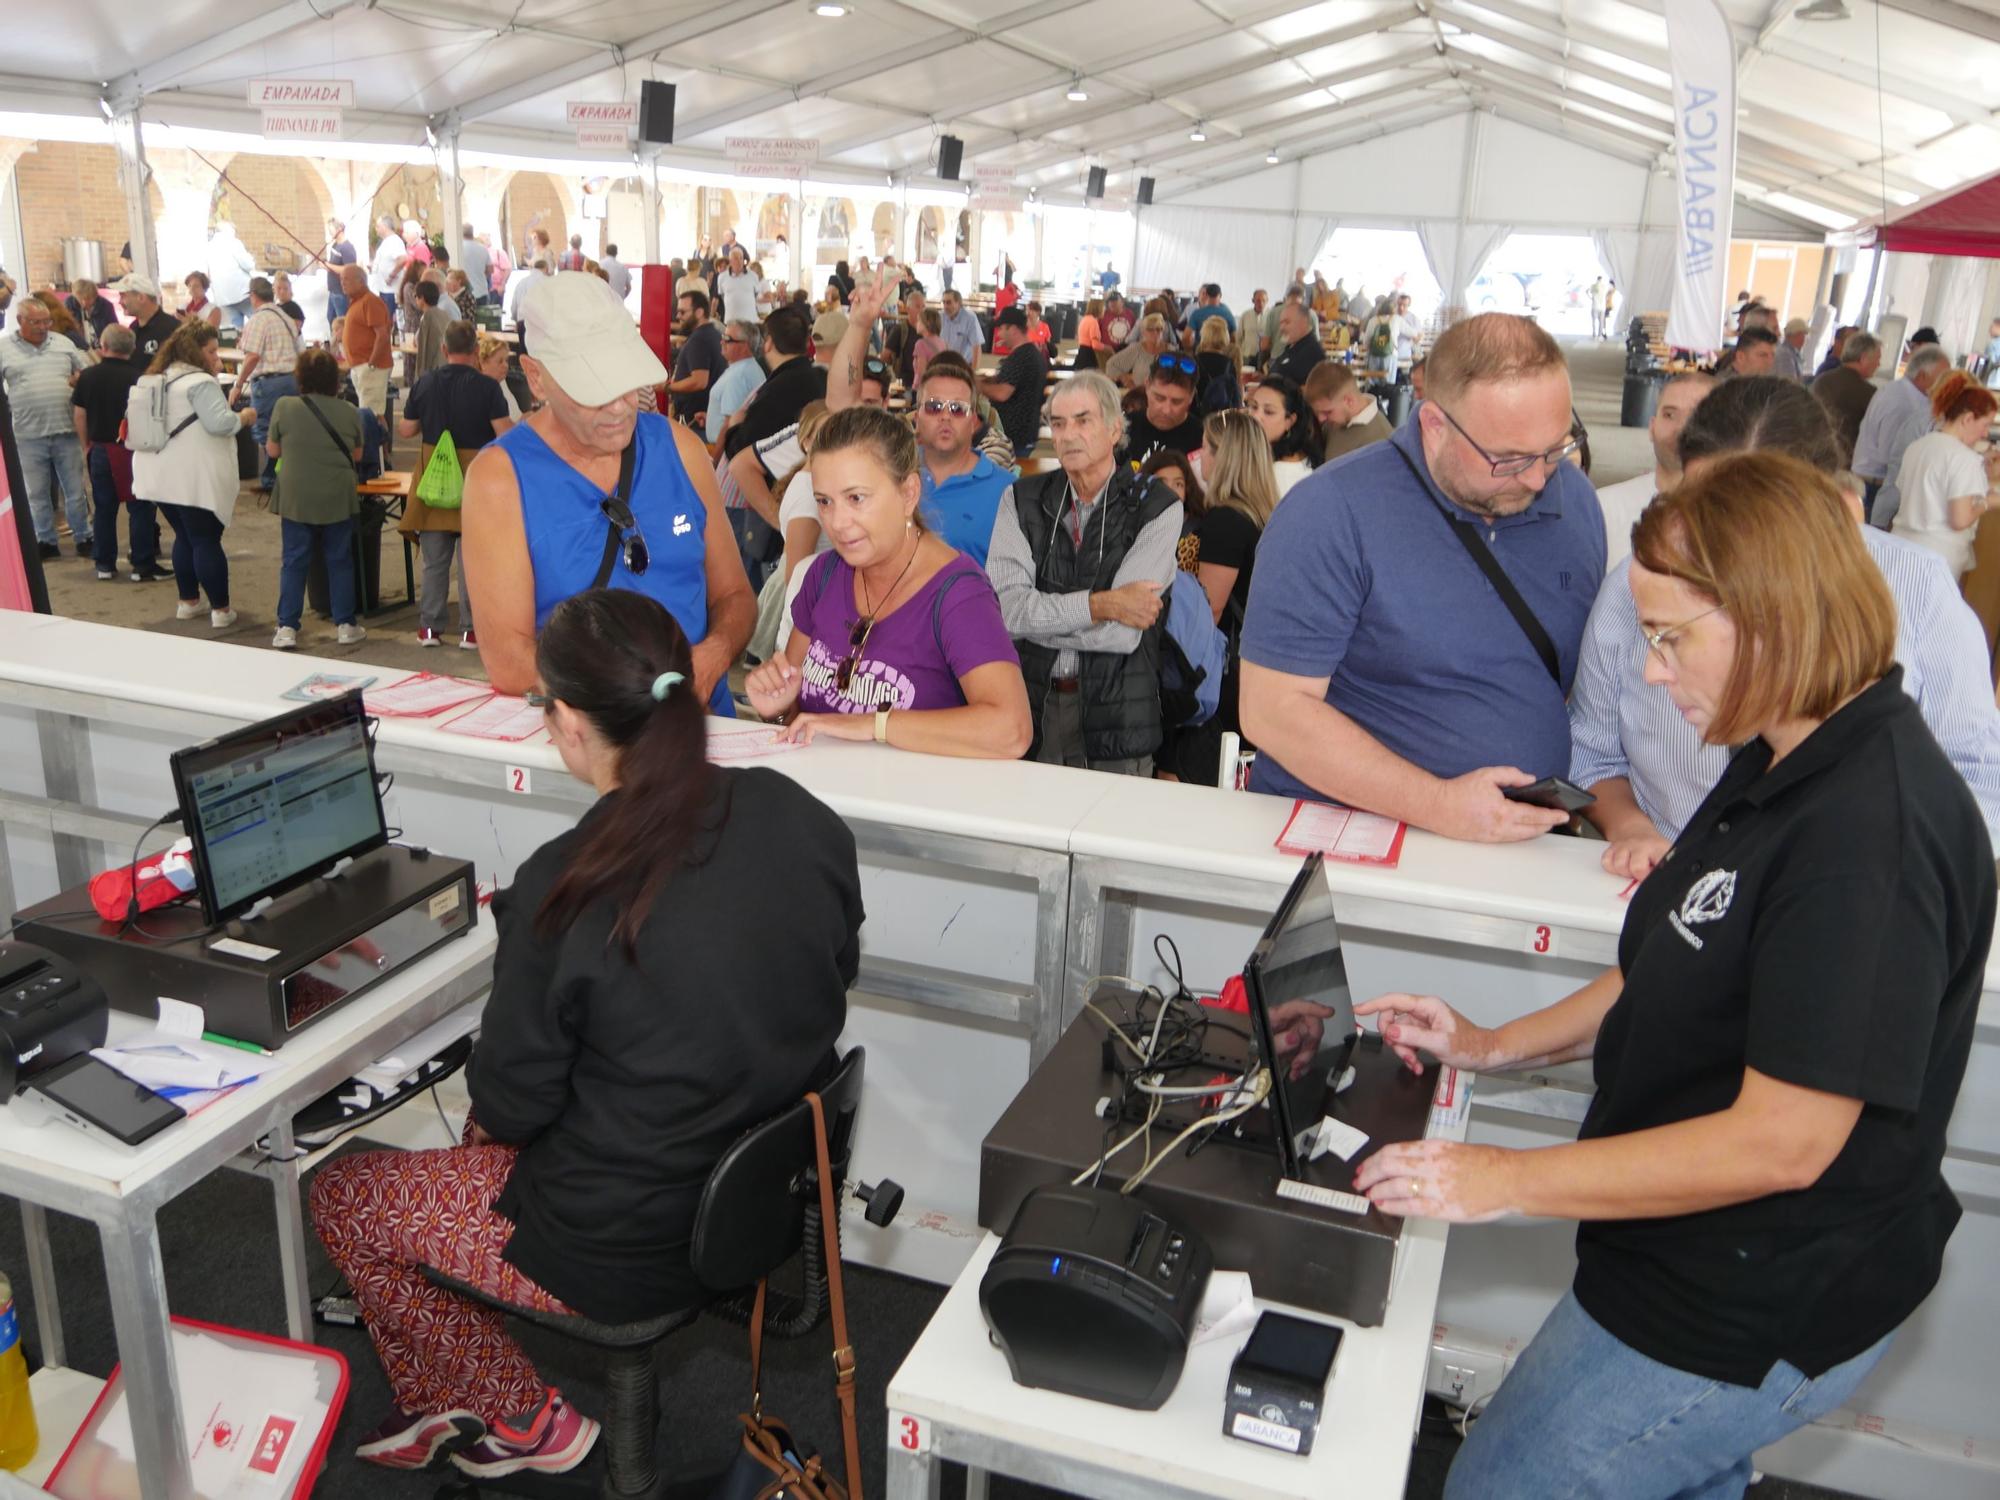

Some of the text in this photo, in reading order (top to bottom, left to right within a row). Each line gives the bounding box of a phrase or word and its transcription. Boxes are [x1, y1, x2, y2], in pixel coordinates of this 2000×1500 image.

[262, 85, 341, 101] EMPANADA
[570, 106, 632, 120] EMPANADA
[513, 768, 524, 791] 2
[1534, 925, 1551, 952] 3
[260, 1427, 284, 1461] P2
[901, 1416, 919, 1449] 3
